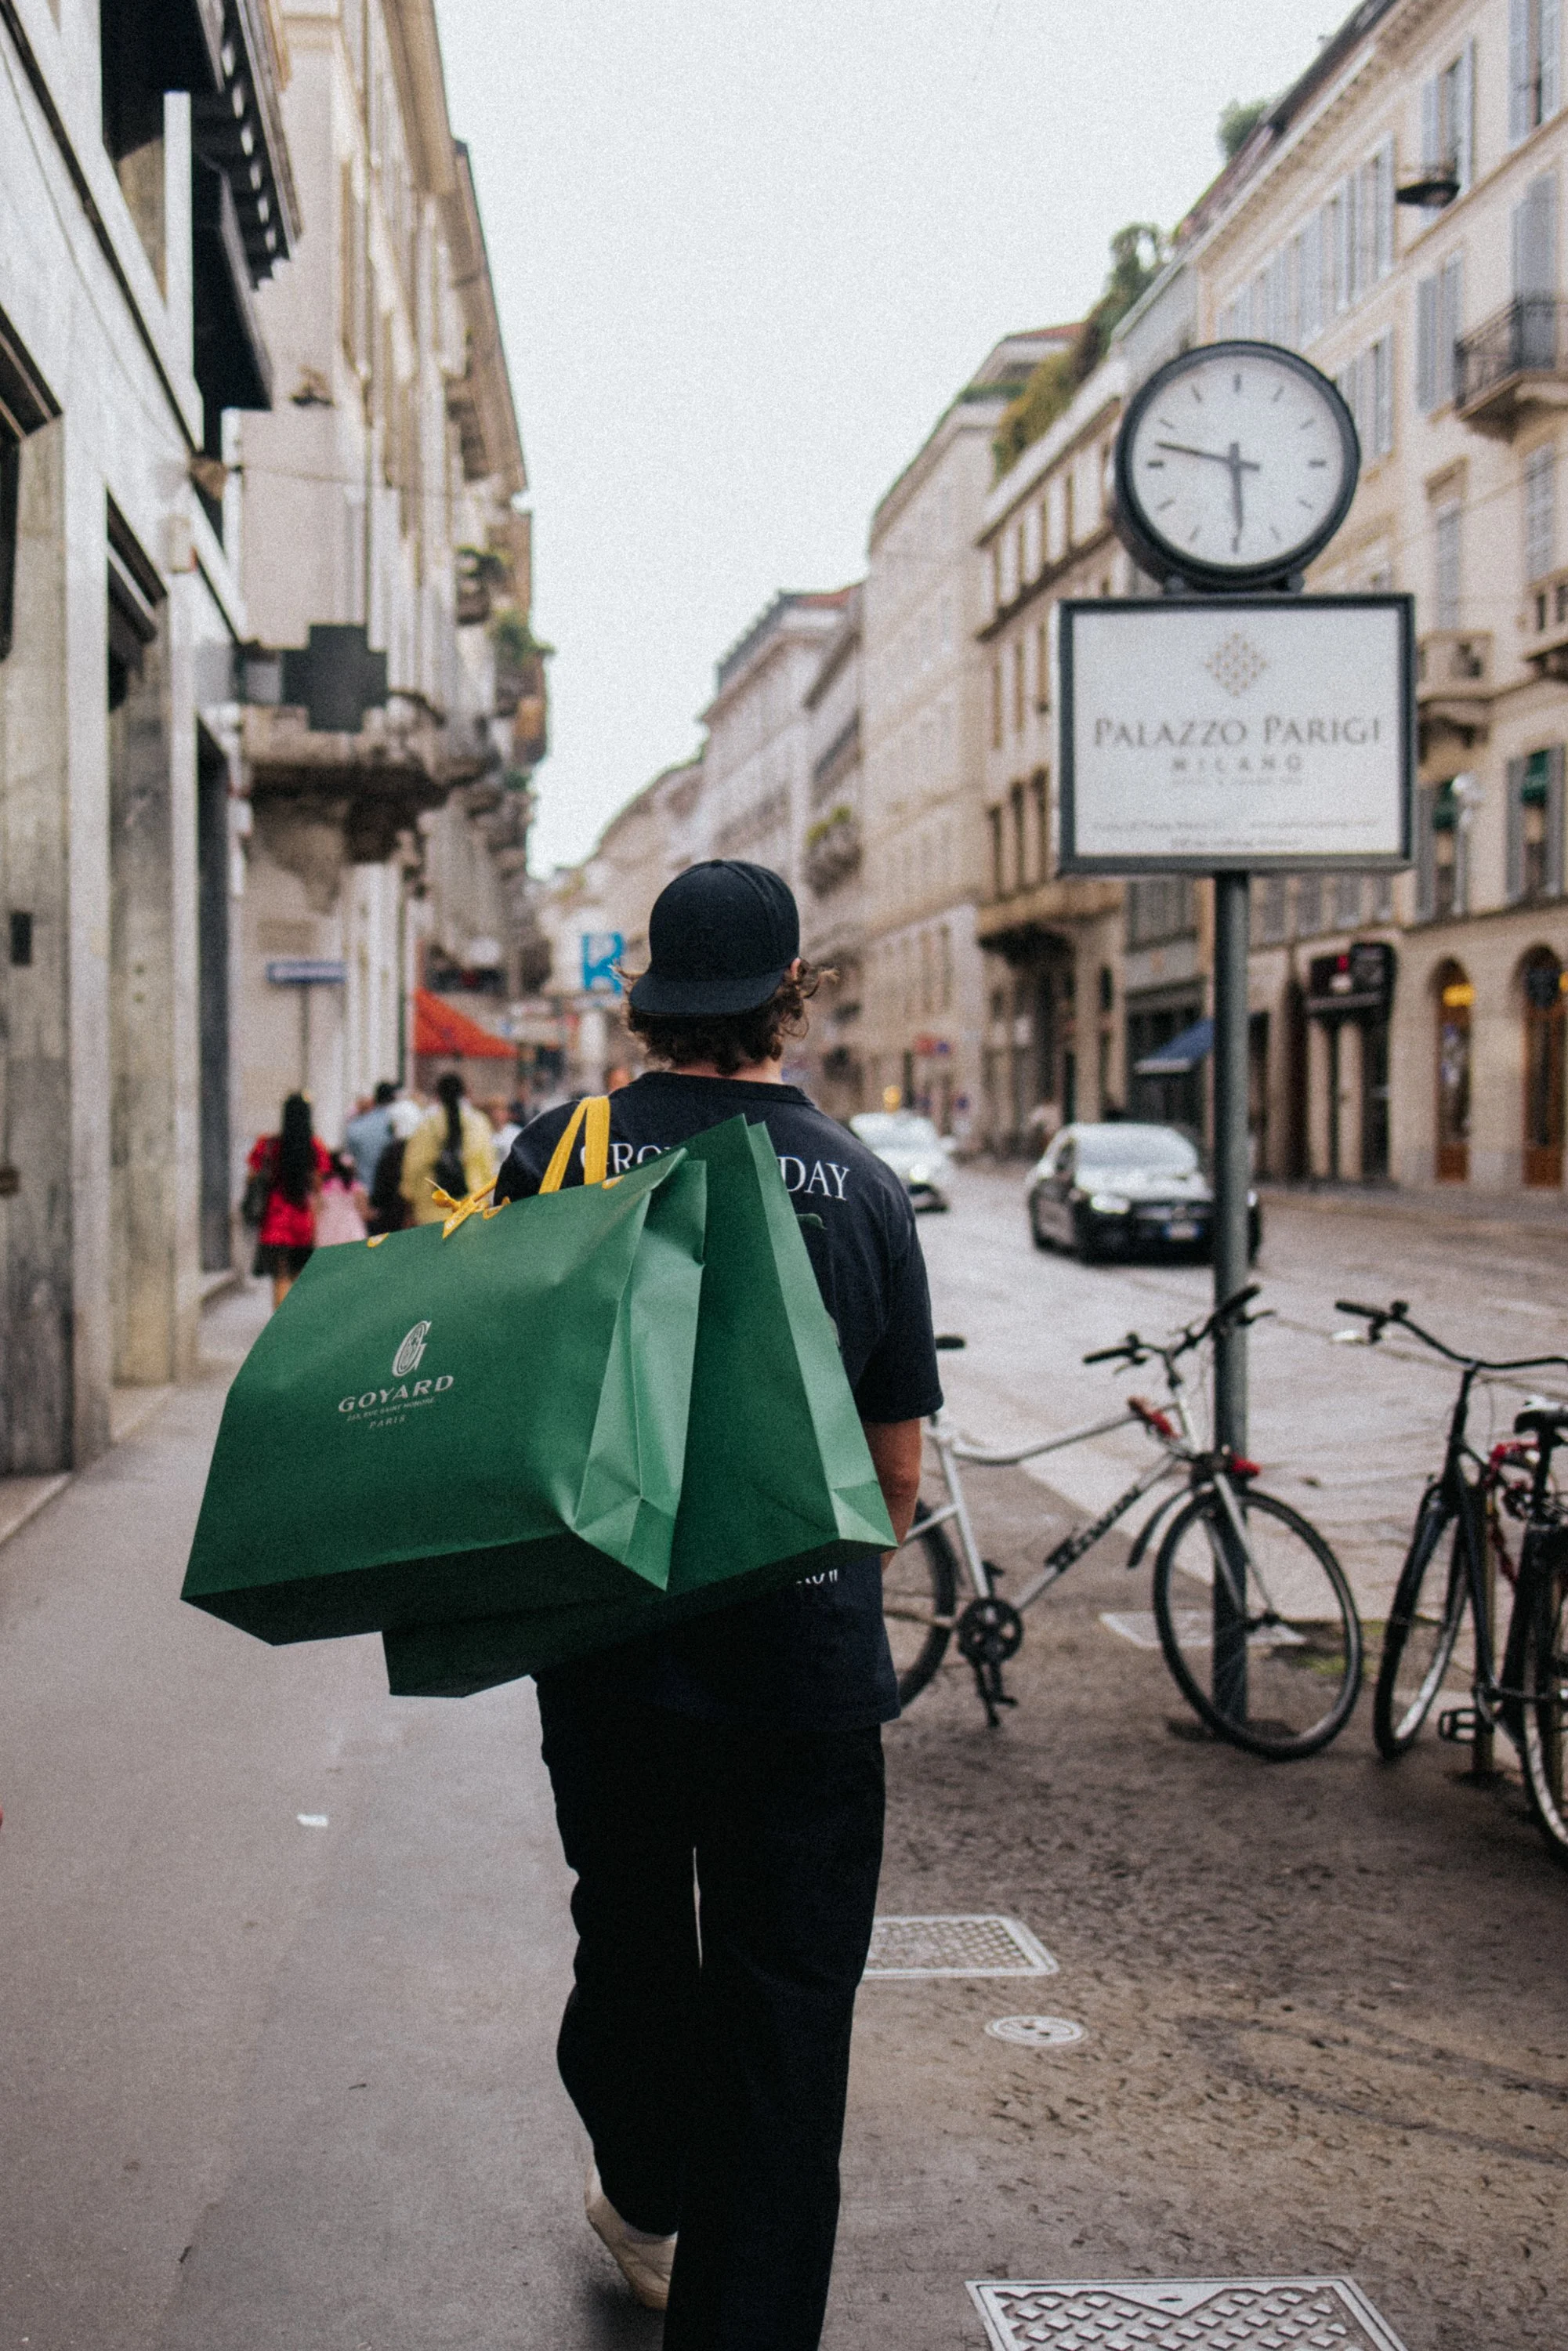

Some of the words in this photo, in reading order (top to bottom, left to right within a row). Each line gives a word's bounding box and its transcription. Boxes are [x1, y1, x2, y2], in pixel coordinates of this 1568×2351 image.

[1095, 716, 1247, 748] PALAZZO
[1263, 715, 1382, 745] PARIGI
[1172, 755, 1304, 773] MILANO
[777, 1156, 850, 1201] DAY
[338, 1375, 454, 1413] GOYARD
[369, 1414, 407, 1429] PARIS
